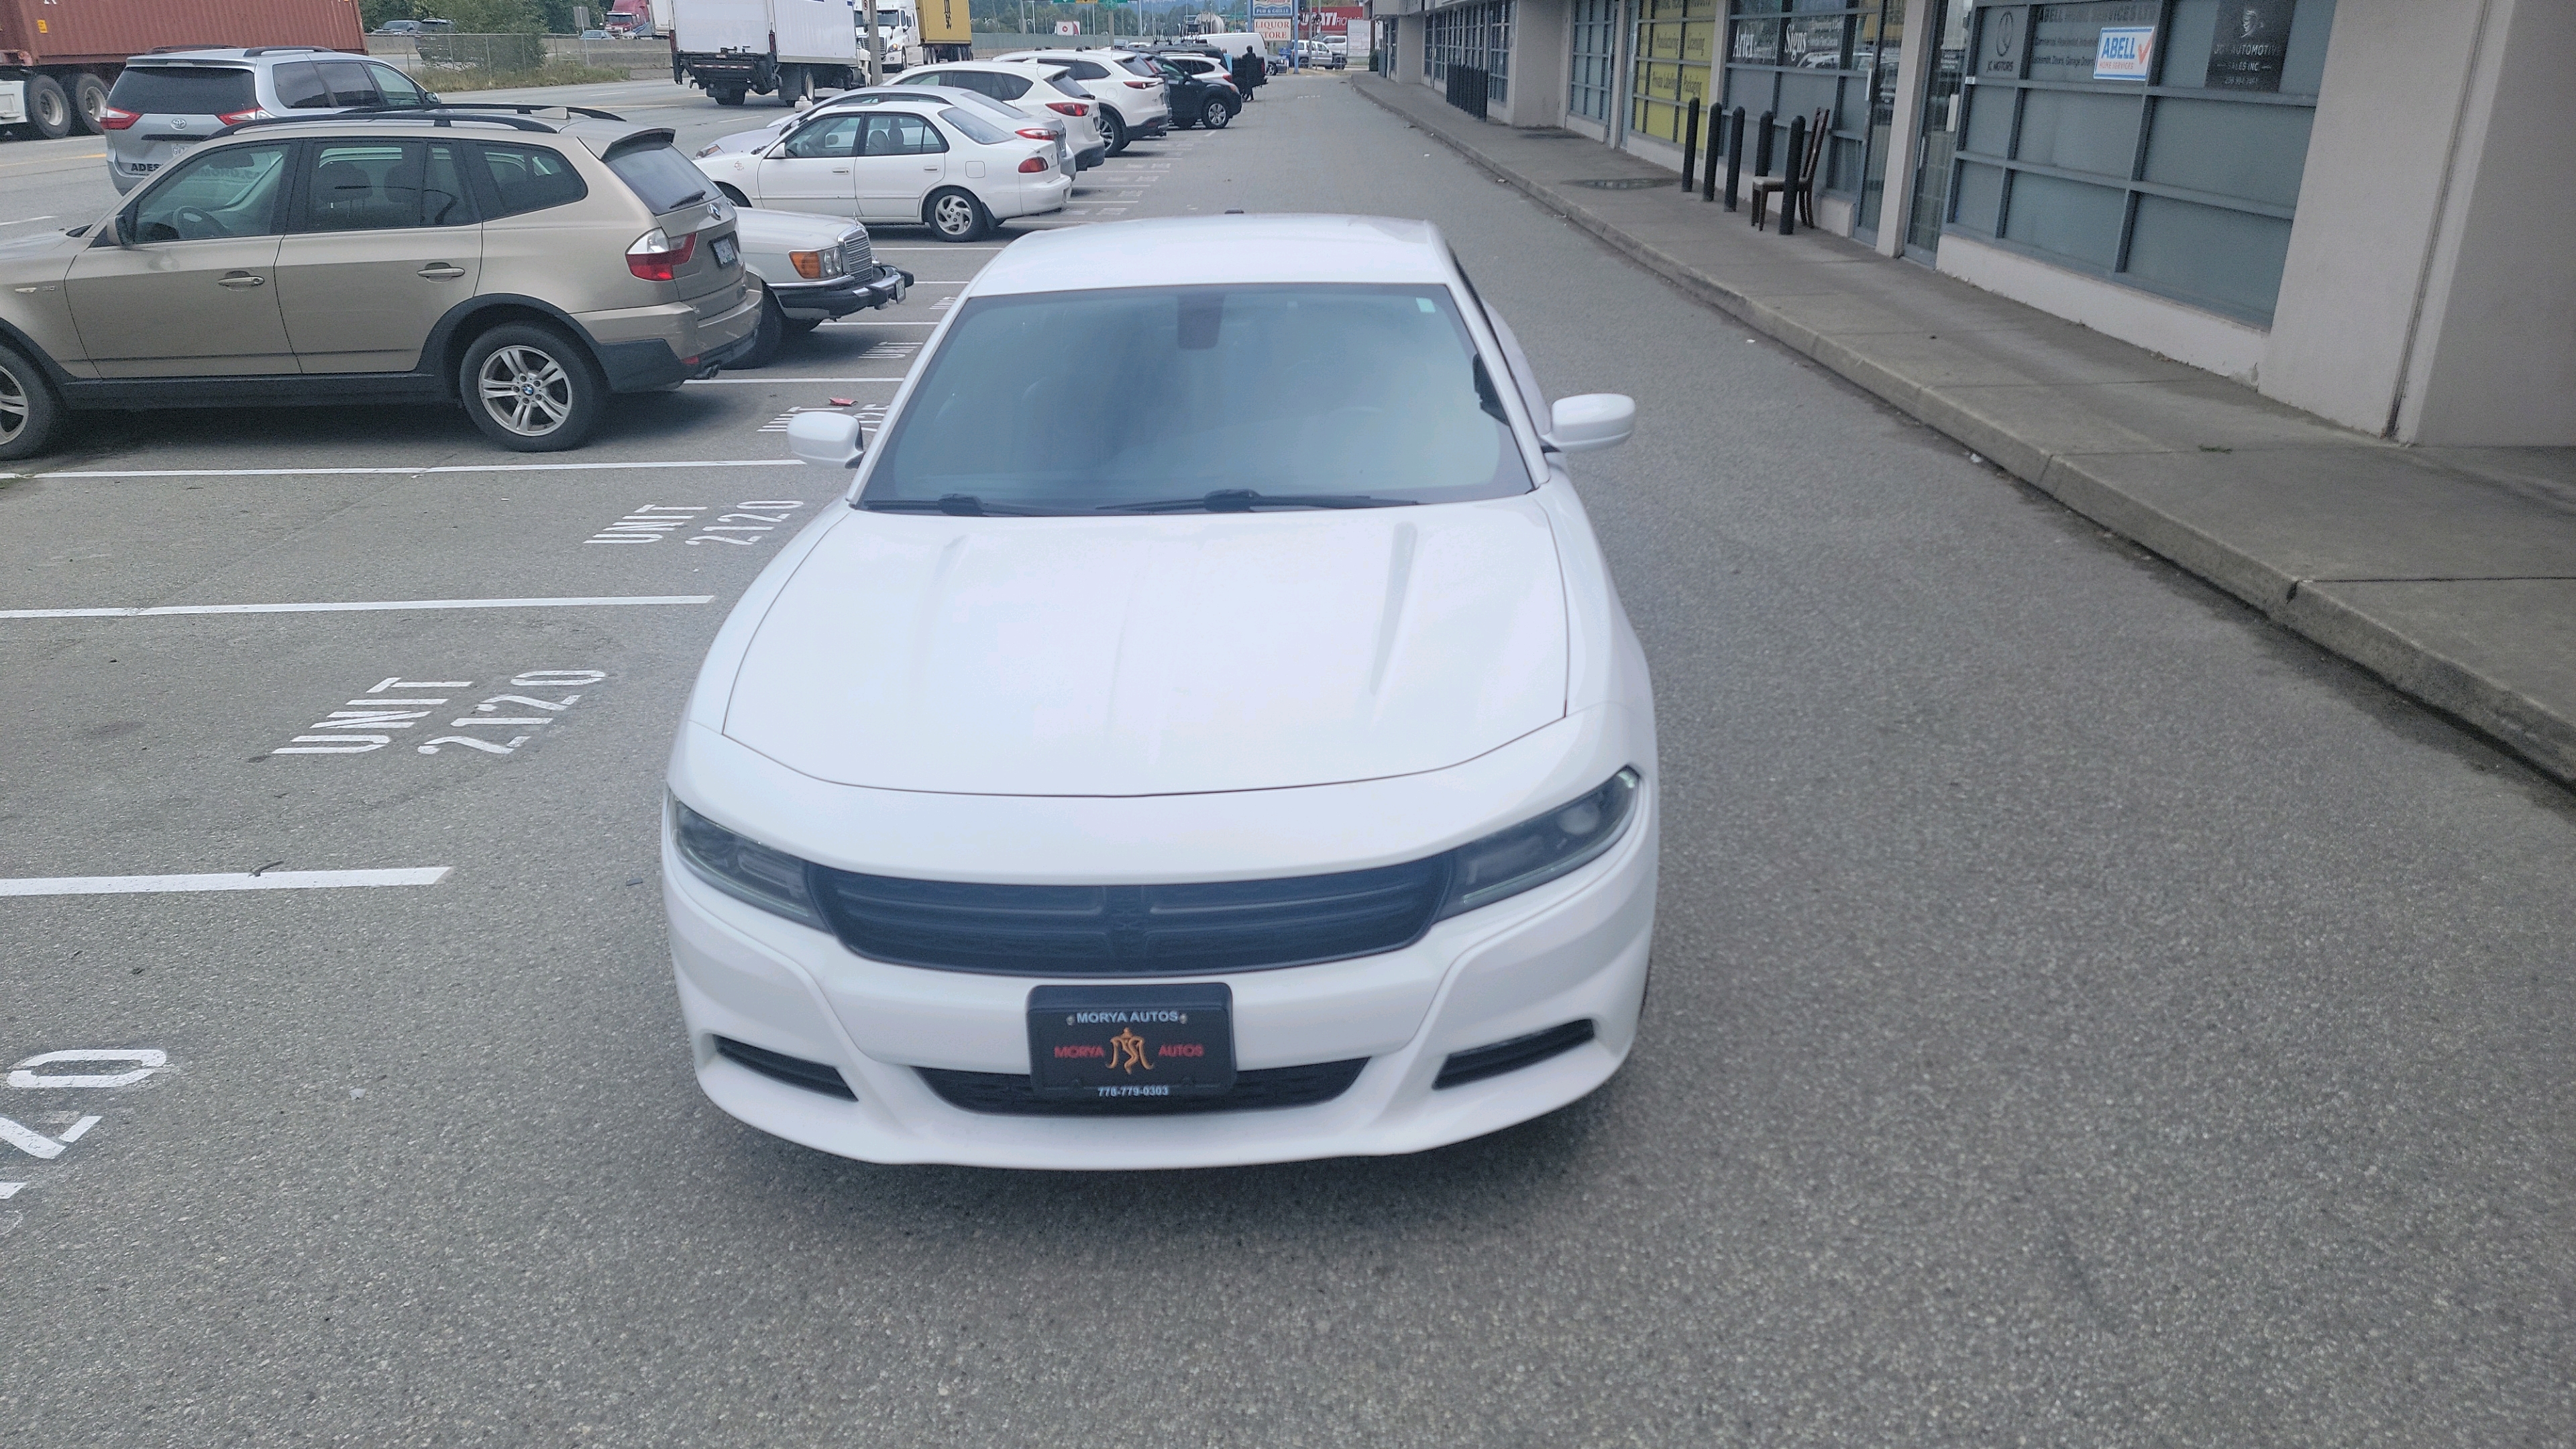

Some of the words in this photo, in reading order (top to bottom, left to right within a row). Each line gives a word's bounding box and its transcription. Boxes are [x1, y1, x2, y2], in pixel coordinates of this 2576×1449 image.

[1255, 21, 1289, 30] LIQUOR
[1784, 23, 1807, 62] Signs
[2101, 36, 2135, 59] ABELL
[858, 341, 923, 358] UNIT
[583, 504, 708, 544] UNIT
[685, 500, 804, 545] 2120
[271, 677, 474, 754] UNIT
[417, 669, 605, 755] 2120
[1077, 1012, 1127, 1024] MORYA
[1130, 1011, 1179, 1023] AUTOS
[1054, 1045, 1105, 1058] MORYA
[1158, 1044, 1204, 1057] AUTOS
